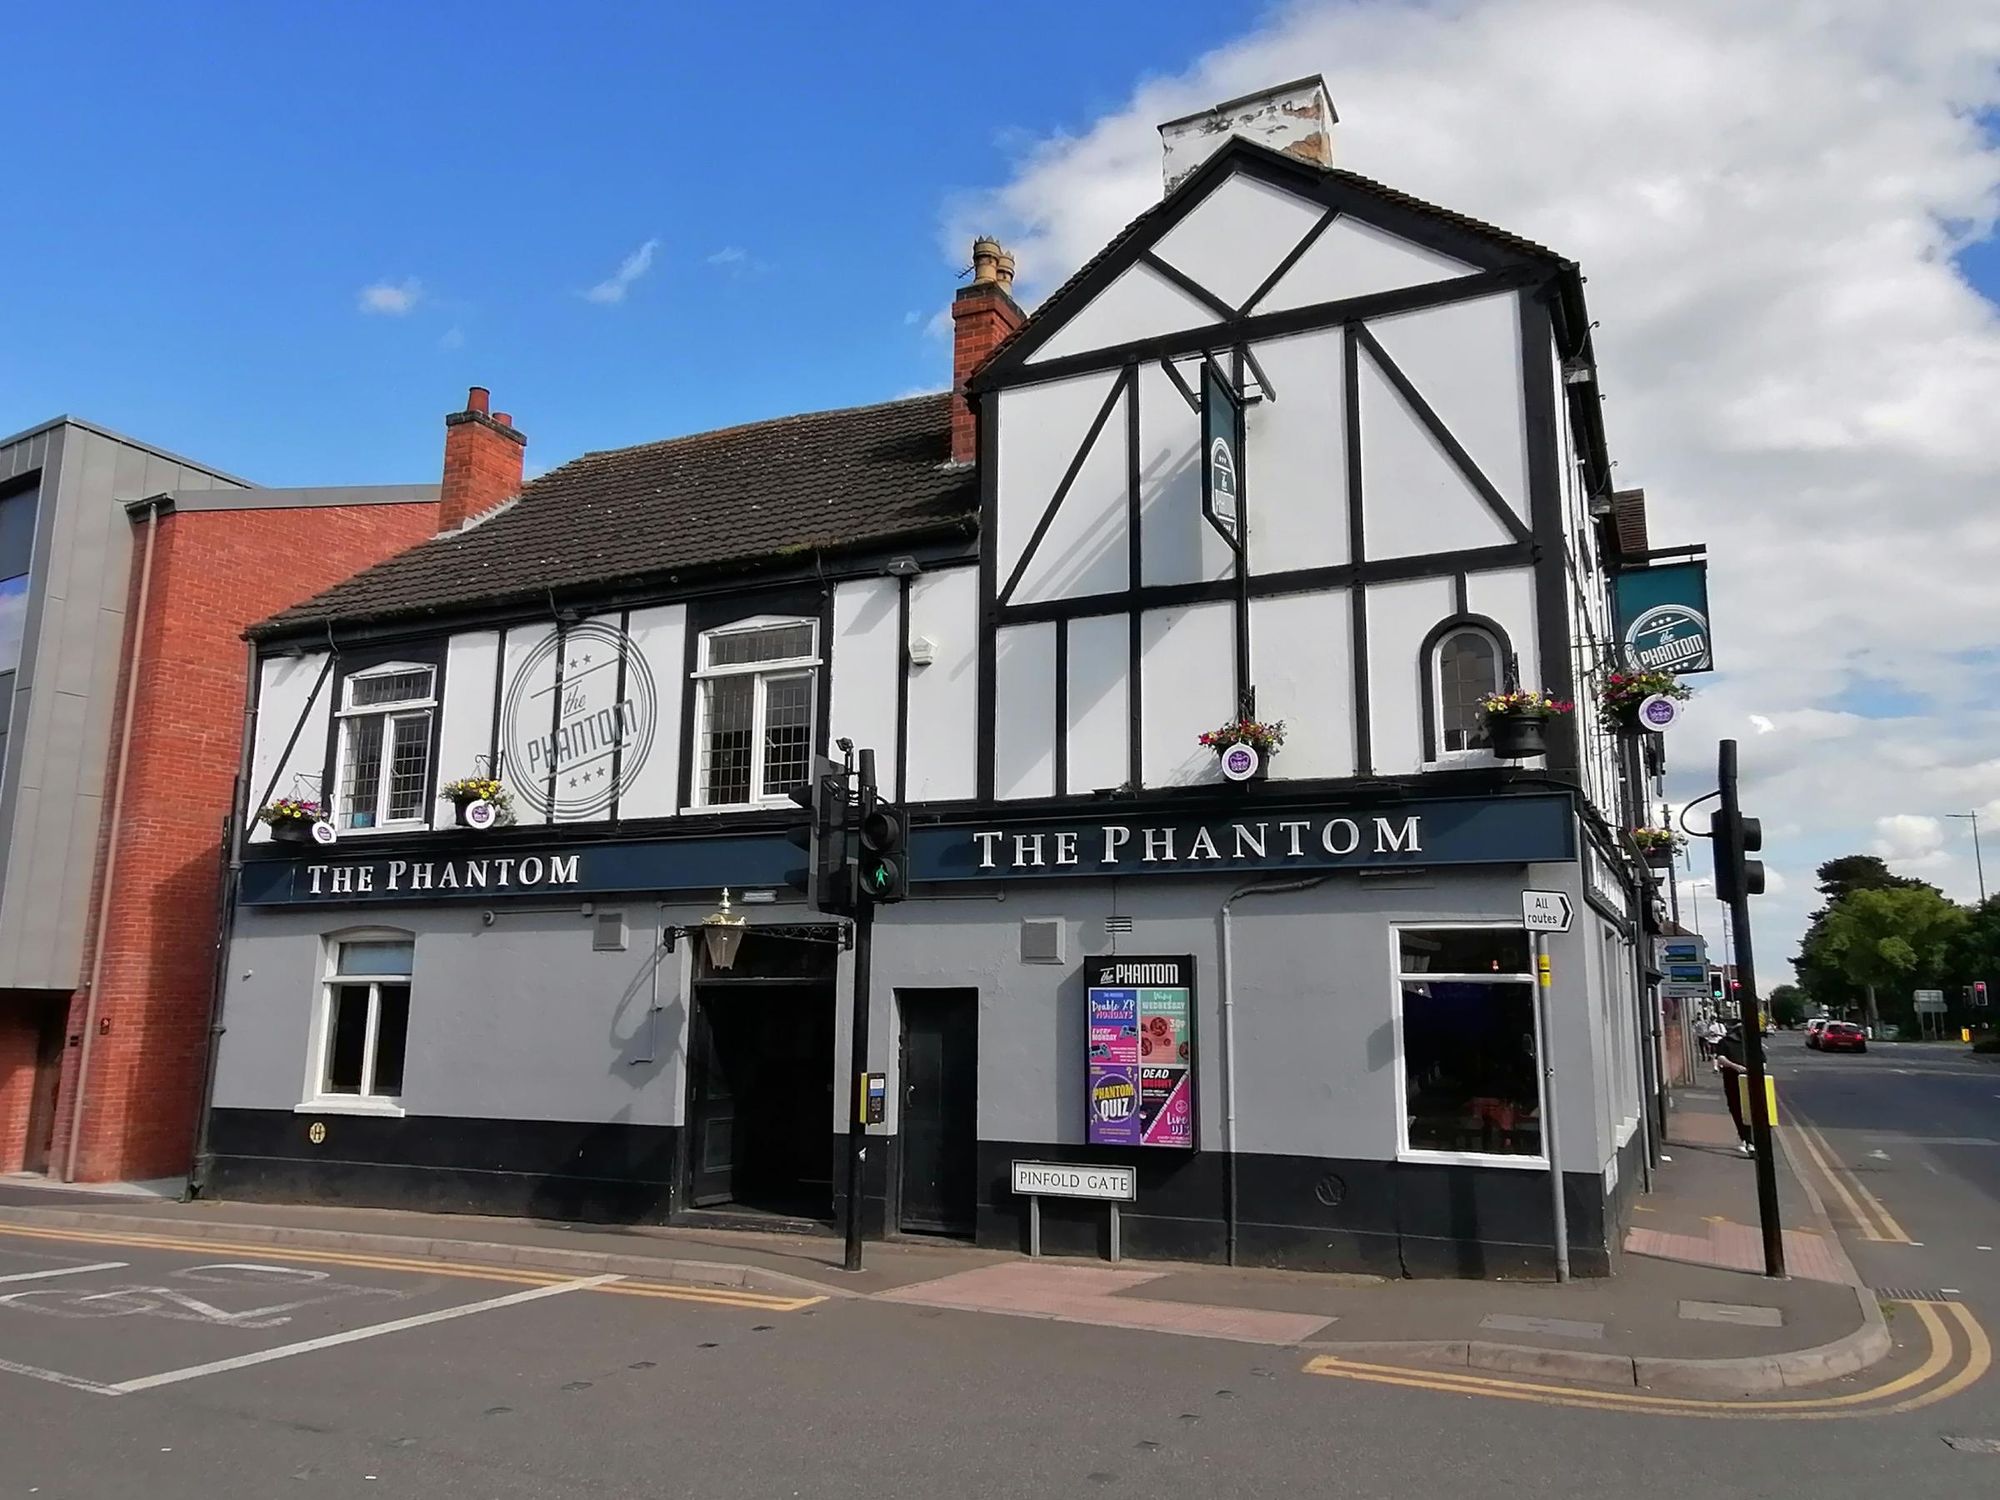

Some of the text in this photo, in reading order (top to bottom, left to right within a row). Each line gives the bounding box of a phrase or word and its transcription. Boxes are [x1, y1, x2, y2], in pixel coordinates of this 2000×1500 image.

[1641, 634, 1704, 666] PHANTOM
[563, 685, 586, 715] the
[527, 699, 637, 774] PHANTOM
[972, 816, 1422, 868] THE PHANTOM
[307, 855, 580, 894] THE PHANTOM
[1535, 898, 1549, 909] All
[1527, 914, 1558, 924] routes
[1116, 963, 1179, 984] PHANTOM
[1142, 1068, 1170, 1079] DEAD
[1094, 1083, 1134, 1100] PHANTOM
[1100, 1097, 1129, 1122] QUIZ
[1020, 1171, 1129, 1192] PINFOLD GATE
